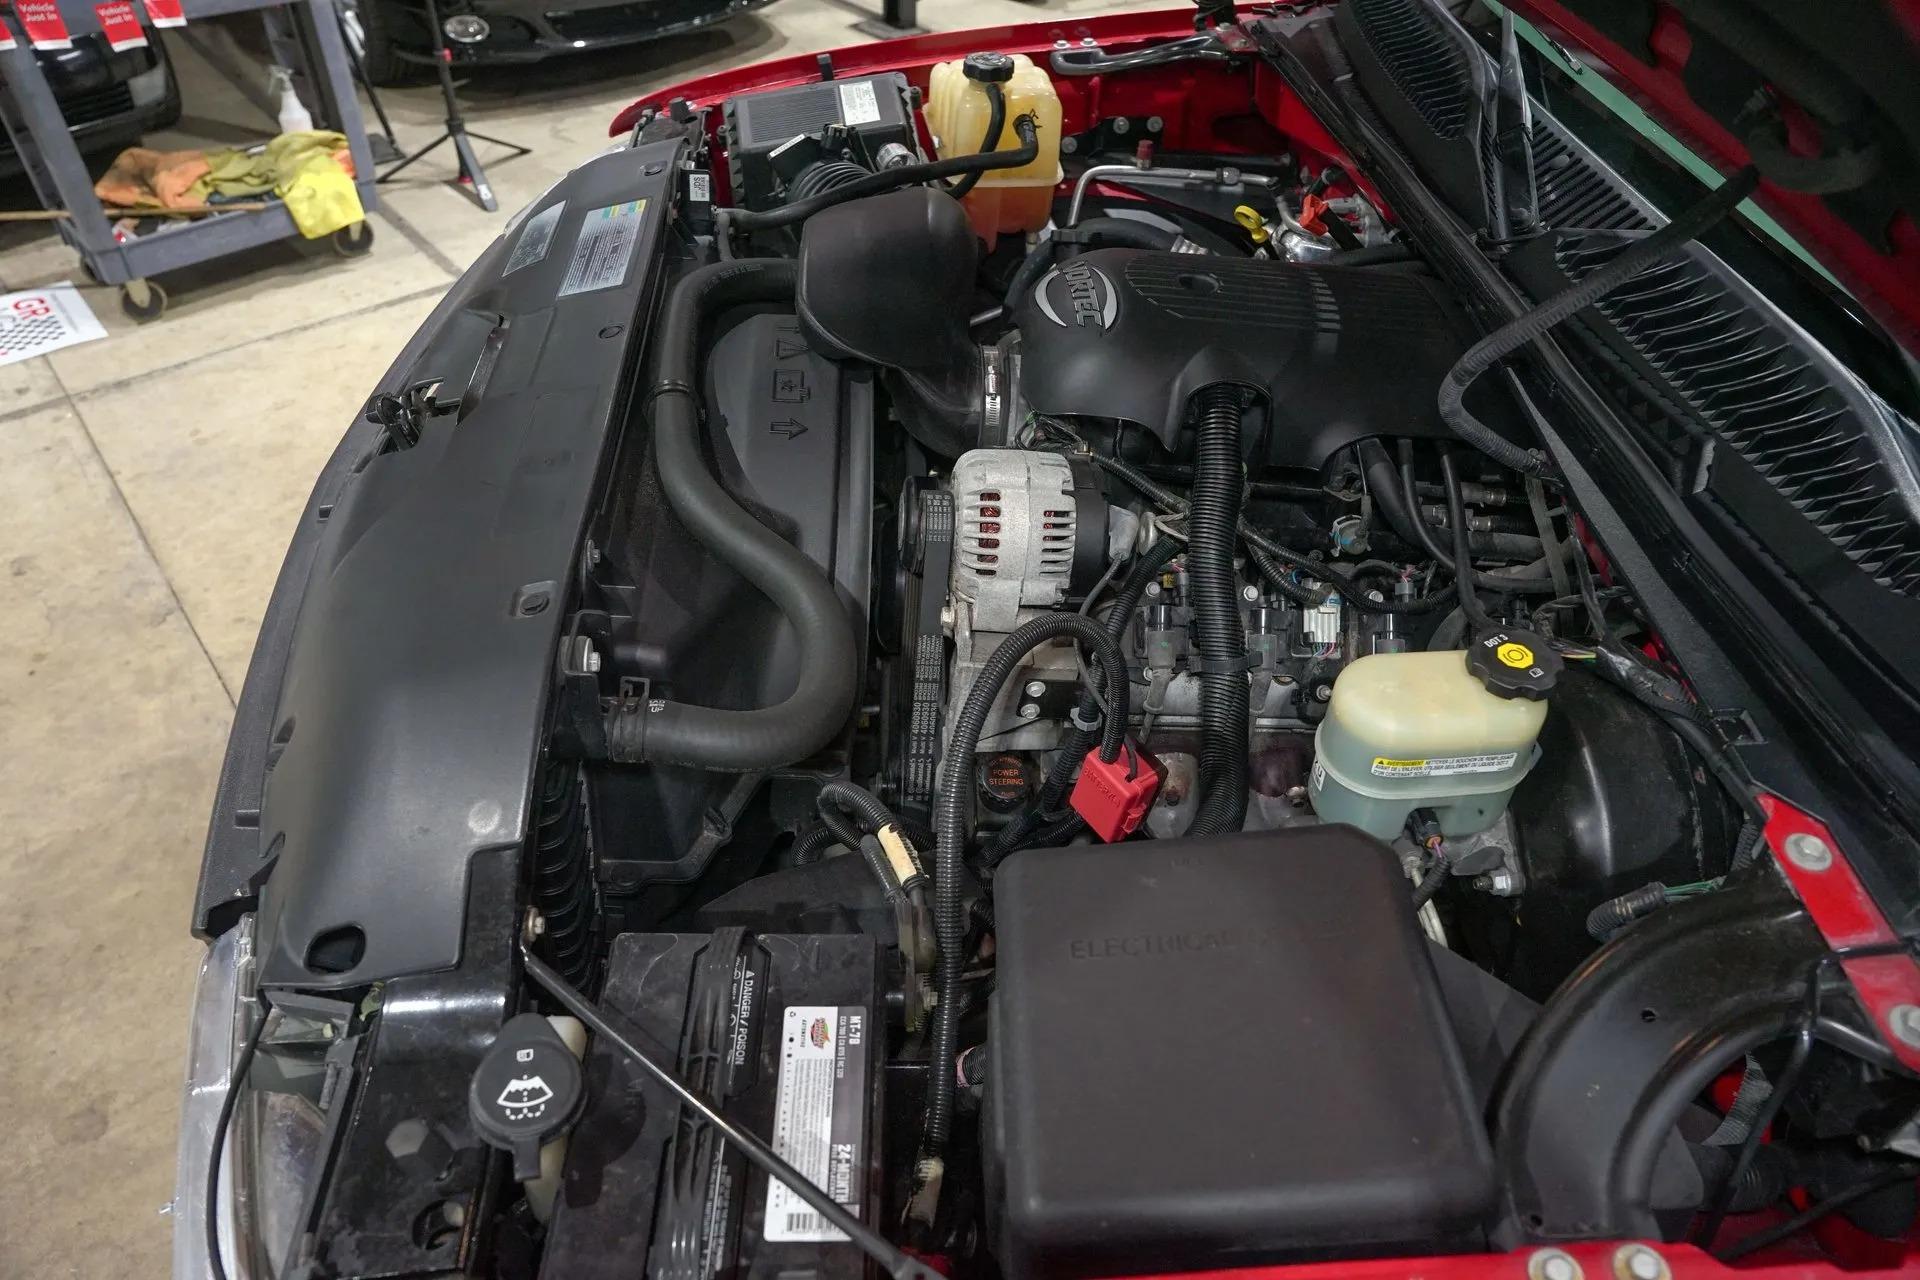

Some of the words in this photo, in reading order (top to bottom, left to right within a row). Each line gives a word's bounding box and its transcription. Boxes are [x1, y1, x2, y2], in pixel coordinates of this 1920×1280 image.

[1061, 260, 1103, 327] VORTEC
[1483, 635, 1502, 648] DOT
[912, 702, 921, 735] 4060930
[920, 702, 930, 735] 4060930
[988, 778, 1024, 786] STEERING
[993, 769, 1019, 777] POWER
[740, 980, 754, 1018] DANGER
[735, 1028, 748, 1065] POISON
[849, 1015, 862, 1045] MT-78
[836, 1144, 852, 1203] 24-MONTH
